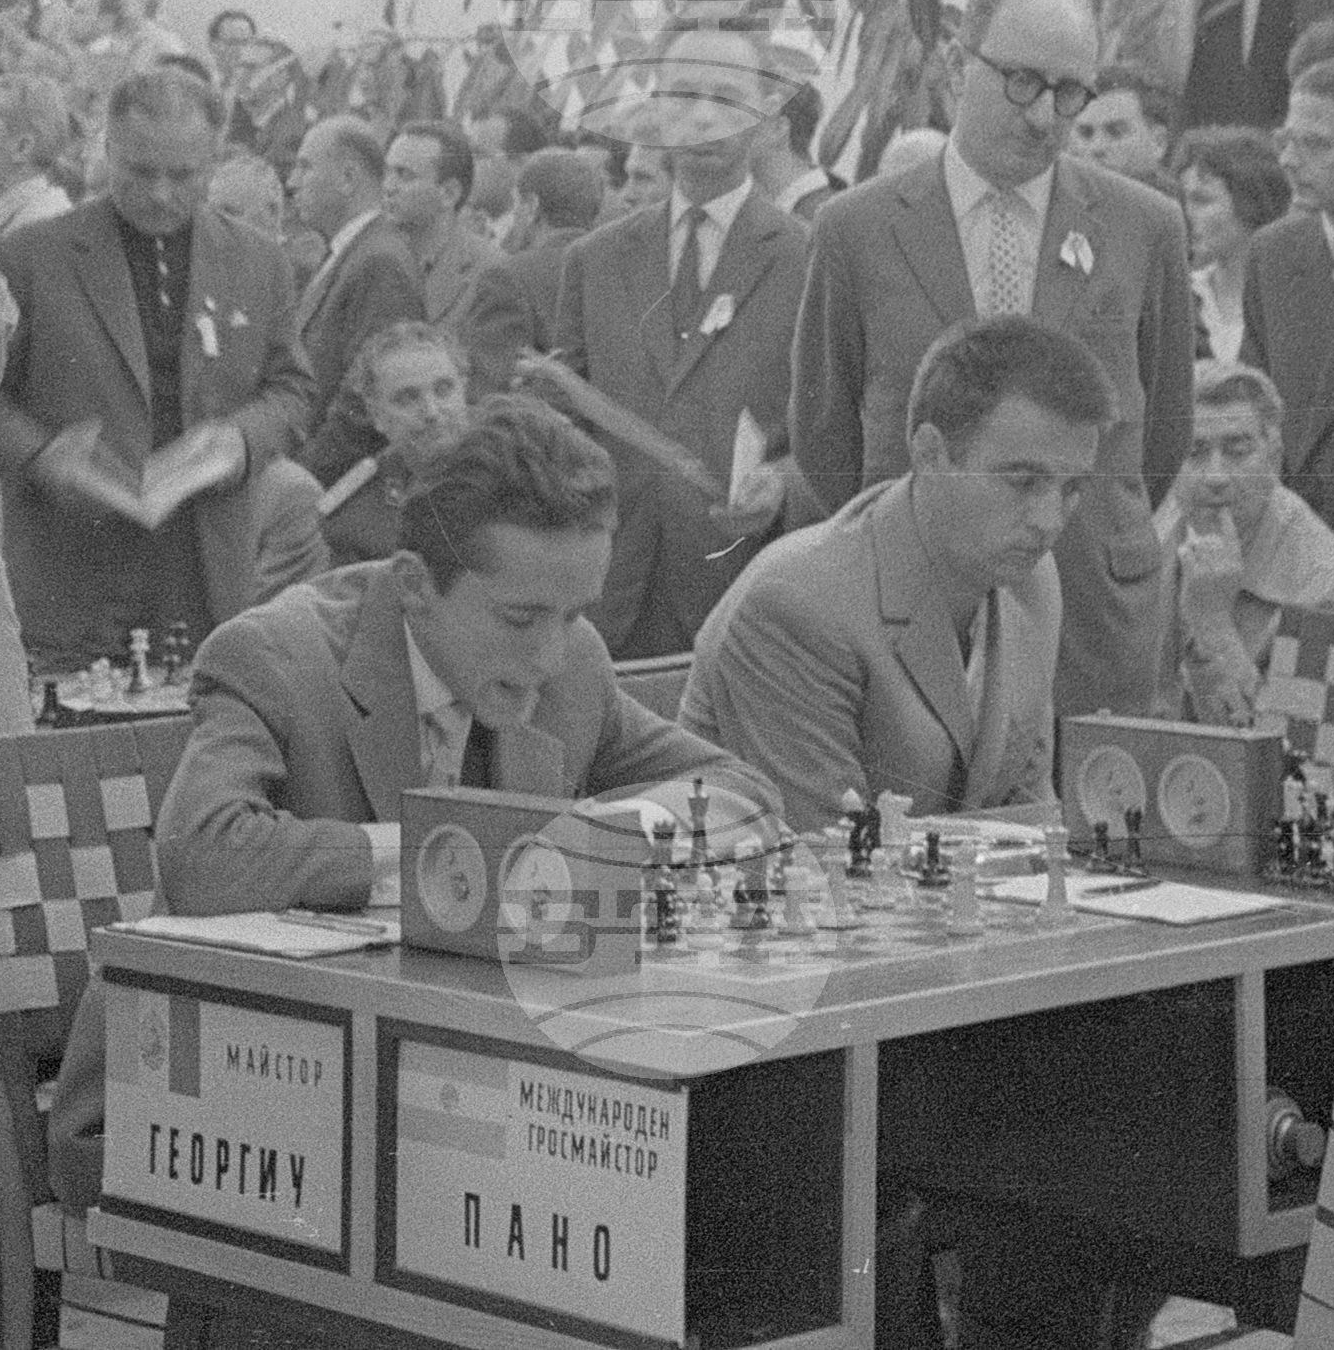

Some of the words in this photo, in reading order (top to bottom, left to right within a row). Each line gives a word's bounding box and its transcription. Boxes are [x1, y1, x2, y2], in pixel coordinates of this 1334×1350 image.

[226, 1044, 323, 1087] МАЙСТОР
[520, 1080, 670, 1142] МЕЖДУНАРОДЕН
[149, 1123, 305, 1209] ГЕОРГИУ
[528, 1123, 658, 1190] ГРОСМАЙСТОР
[464, 1192, 611, 1282] ПАНО
